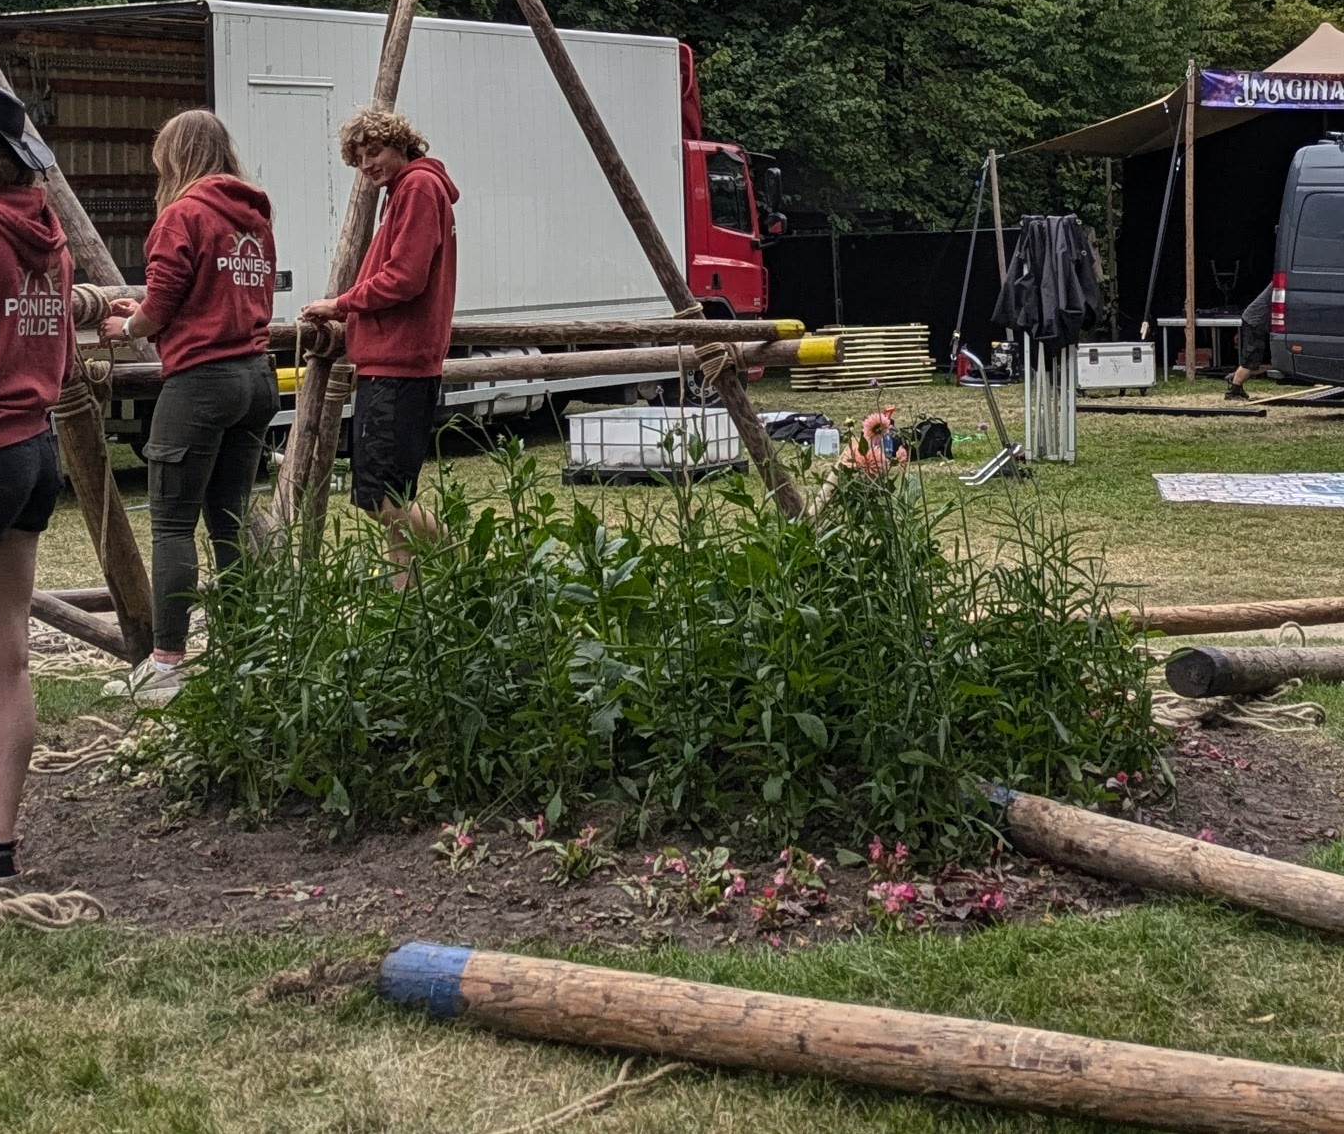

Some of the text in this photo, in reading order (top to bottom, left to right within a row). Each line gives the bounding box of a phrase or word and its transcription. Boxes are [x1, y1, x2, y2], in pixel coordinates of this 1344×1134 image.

[232, 272, 264, 287] GILDE
[4, 297, 66, 316] PONIER
[17, 318, 59, 336] GILDE
